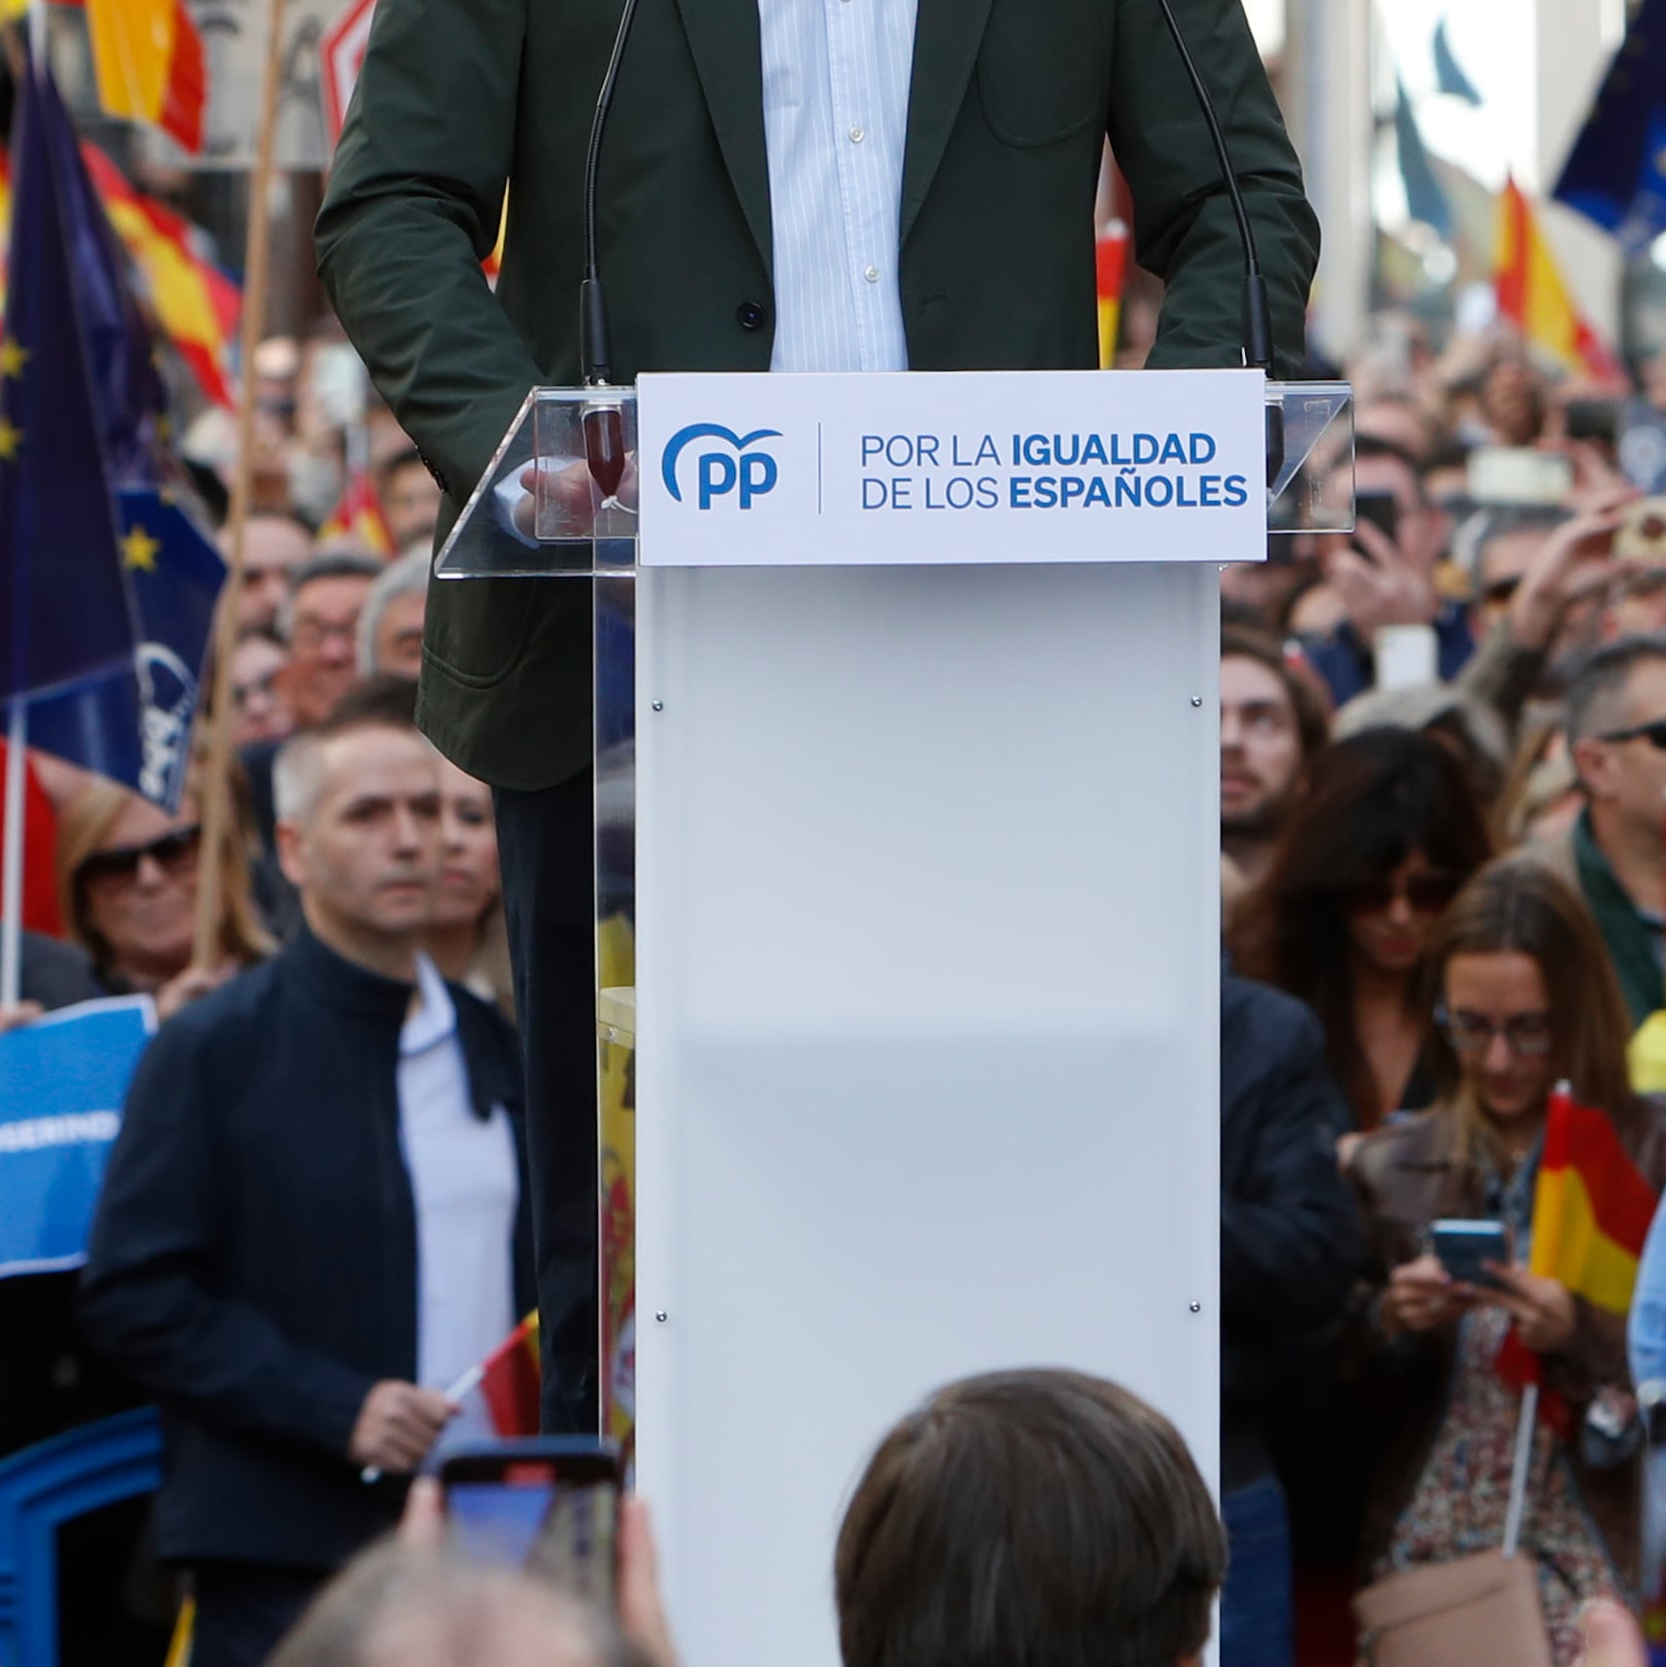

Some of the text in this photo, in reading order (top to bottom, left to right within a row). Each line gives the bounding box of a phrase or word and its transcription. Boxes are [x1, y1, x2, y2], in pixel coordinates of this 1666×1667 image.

[861, 433, 1217, 467] POR LA IGUALDAD
[862, 467, 1248, 509] DE LOS ESPAÑOLES
